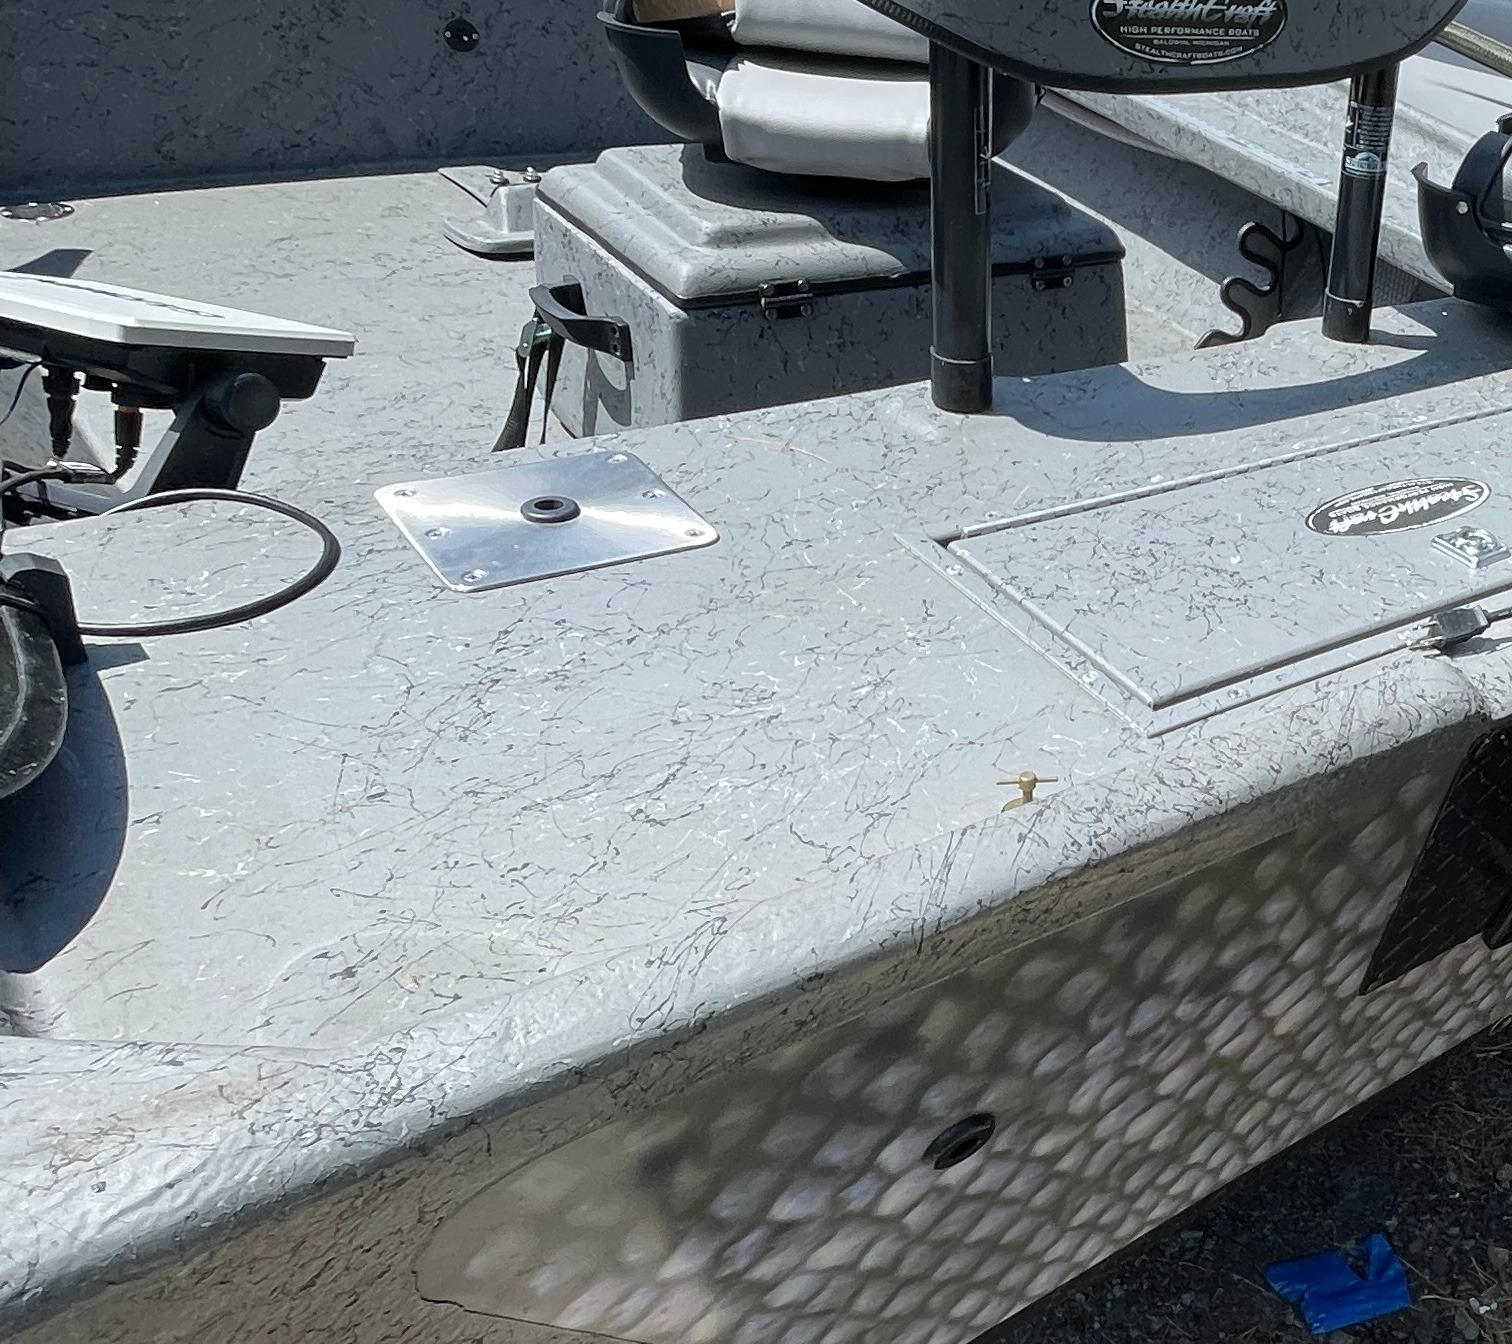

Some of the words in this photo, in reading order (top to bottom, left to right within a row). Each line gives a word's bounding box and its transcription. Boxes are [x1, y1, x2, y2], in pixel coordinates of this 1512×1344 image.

[1120, 25, 1148, 34] HIGH
[1150, 26, 1225, 36] PERFORMANCE
[1228, 28, 1260, 37] BOATS
